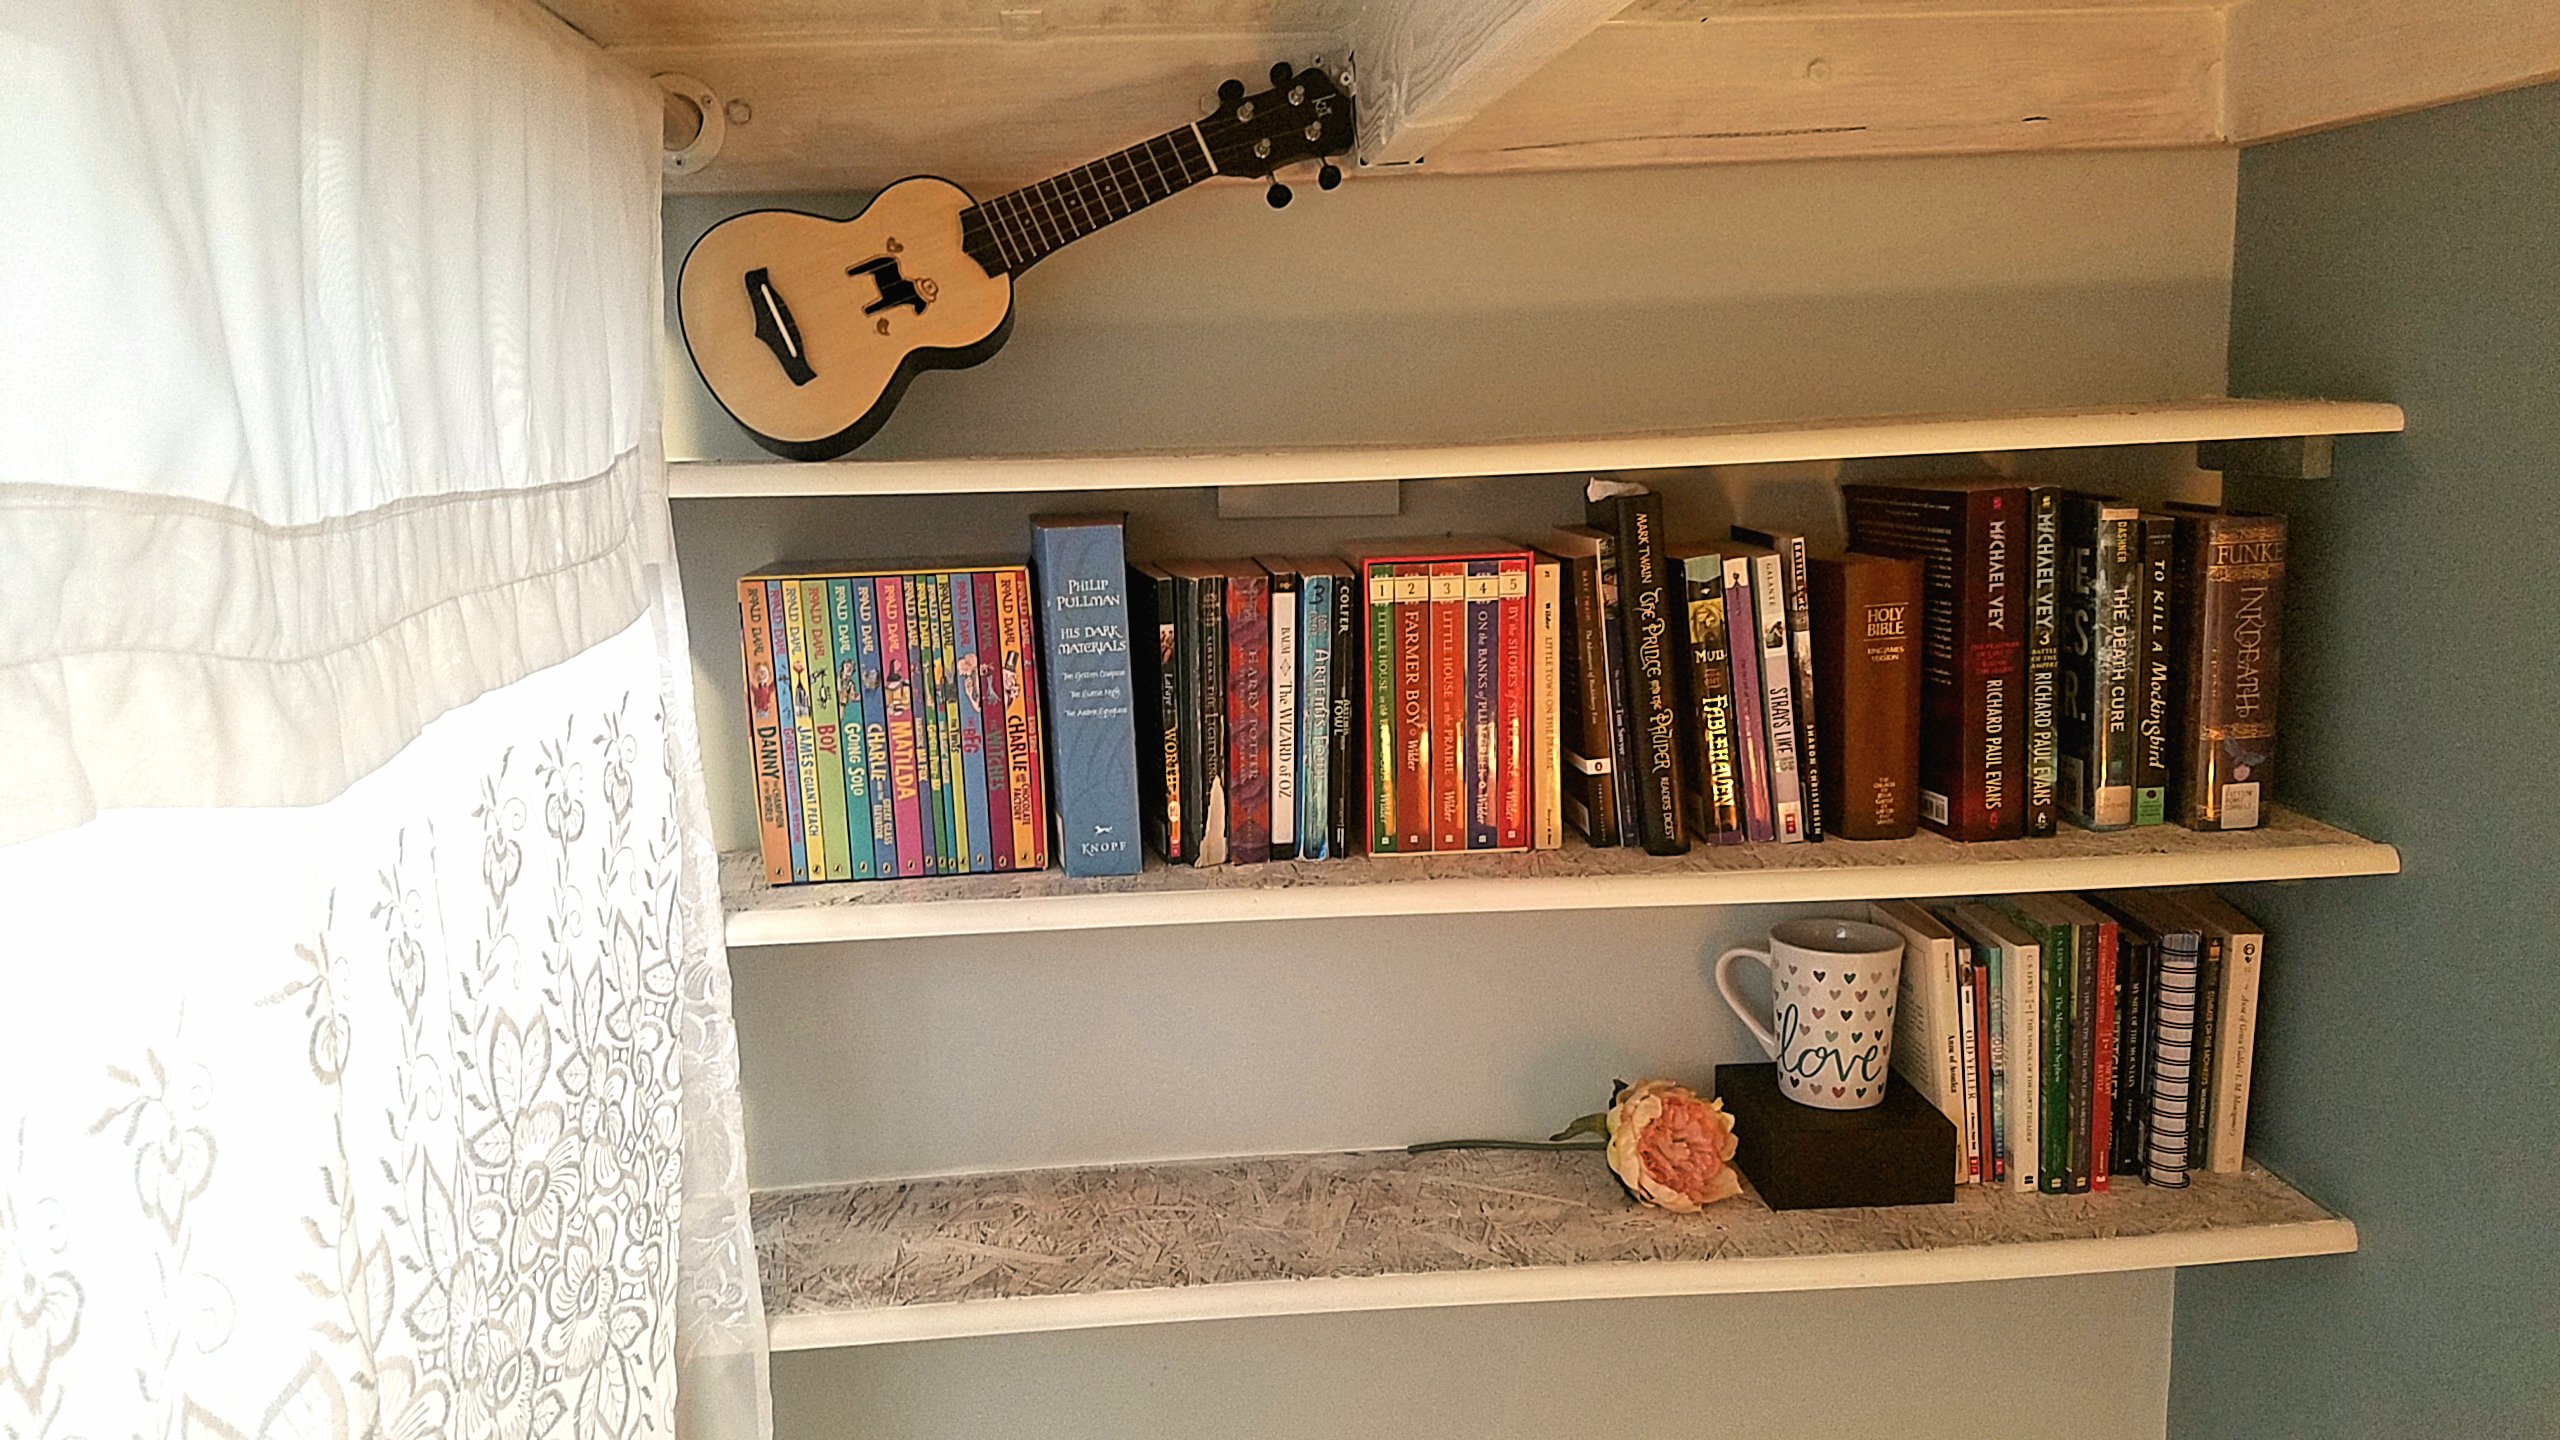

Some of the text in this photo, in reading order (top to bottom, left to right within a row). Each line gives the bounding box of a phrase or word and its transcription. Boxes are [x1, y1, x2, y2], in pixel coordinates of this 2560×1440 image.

[1636, 513, 1652, 584] MARK TWAIN
[2116, 521, 2128, 563] DASHNER
[2217, 542, 2283, 567] FUNKE
[1056, 594, 1121, 611] PULLMAN
[1068, 579, 1109, 595] PHILIP
[1380, 585, 1384, 597] 1
[1408, 582, 1416, 594] 2
[1443, 583, 1451, 595] 3
[1479, 582, 1488, 595] 4
[1510, 579, 1518, 590] 5
[1766, 562, 1776, 606] GALANTE
[1987, 521, 2005, 630] MICHAEL VEY
[2035, 514, 2055, 645] MICHAEL VEY 3
[748, 588, 763, 656] ROALD DAHL
[770, 590, 785, 656] ROALD DAHL
[786, 588, 801, 655] ROALD DAHL
[808, 587, 825, 660] ROALD DAHL
[835, 586, 850, 653] ROALD DAHL
[858, 586, 873, 654] ROALD DAHL
[885, 584, 900, 652] ROALD DAHL
[904, 581, 919, 650] ROALD DAHL
[917, 583, 931, 650] ROALD DAHL
[928, 584, 941, 650] ROALD DAHL
[939, 582, 955, 649] ROALD DAHL
[956, 582, 971, 647] ROALD DAHL
[979, 584, 994, 650] ROALD DAHL
[1001, 579, 1016, 646] ROALD DAHL
[1017, 580, 1032, 648] ROALD DAHL
[1060, 624, 1124, 640] HIS DARK
[1281, 627, 1291, 654] BAUM
[1338, 586, 1350, 635] COLFER
[1868, 607, 1904, 623] HOLY
[1868, 622, 1904, 637] BIBLE
[1058, 640, 1127, 655] MATERIALS
[1378, 612, 1389, 692] LITTLE HOUSE
[1405, 612, 1421, 727] FARMER BOY
[1475, 611, 1488, 701] ON the BANKS of
[1507, 606, 1519, 688] BY SHORES
[1544, 637, 1554, 714] LITTLE TOWN ON
[2110, 586, 2129, 733] THE DEATH CURE
[2141, 560, 2168, 769] TO KILL A Mockingbird
[2234, 586, 2269, 719] INKDEATH
[1162, 673, 1174, 706] LaFaye
[1247, 651, 1259, 780] HARRY POTTER
[1312, 648, 1330, 729] ARTEMIS
[1334, 700, 1344, 736] FOWL
[1443, 610, 1454, 775] LITTLE HOUSE PRAIRIE
[1615, 709, 1624, 727] Tom
[817, 724, 837, 755] BOY
[951, 729, 961, 753] TWITS
[962, 728, 983, 754] BFG
[1008, 715, 1028, 771] CHARLIE
[1279, 683, 1292, 799] The WIZARD of OZ
[1616, 729, 1626, 757] Sawyer
[1769, 687, 1794, 753] STRAYS LIKE
[1985, 680, 2003, 810] RICHARD PAUL EVANS
[2032, 673, 2053, 806] RICHARD PAUL EVANS
[757, 726, 780, 780] DANNY
[798, 726, 819, 836] JAMES GIANT PEACH
[845, 722, 865, 796] GOING SOLO
[867, 724, 888, 781] CHARLIE
[890, 721, 917, 800] MATILDA
[917, 764, 929, 782] FOX
[987, 730, 1006, 790] WITCHES
[1165, 726, 1179, 787] WORTH
[1407, 740, 1419, 771] Wilder
[1702, 695, 1735, 807] FABLEHAVEN
[1807, 724, 1821, 835] SHARON CHRISTENSEN
[884, 823, 893, 845] GLASS
[1014, 787, 1023, 821] FACTORY
[1022, 783, 1031, 826] CHOCOLATE
[1380, 794, 1392, 823] Wilder
[1444, 791, 1456, 822] Wilder
[1477, 794, 1490, 825] Wilder
[1505, 791, 1517, 822] Wilder
[1663, 813, 1675, 840] DIGEST
[1081, 841, 1127, 856] KNOPF
[2240, 995, 2250, 1013] Anne
[1777, 1003, 1882, 1082] love
[1947, 1035, 1959, 1093] Anne of Avonlea
[1965, 1030, 1978, 1099] OLD YELLER
